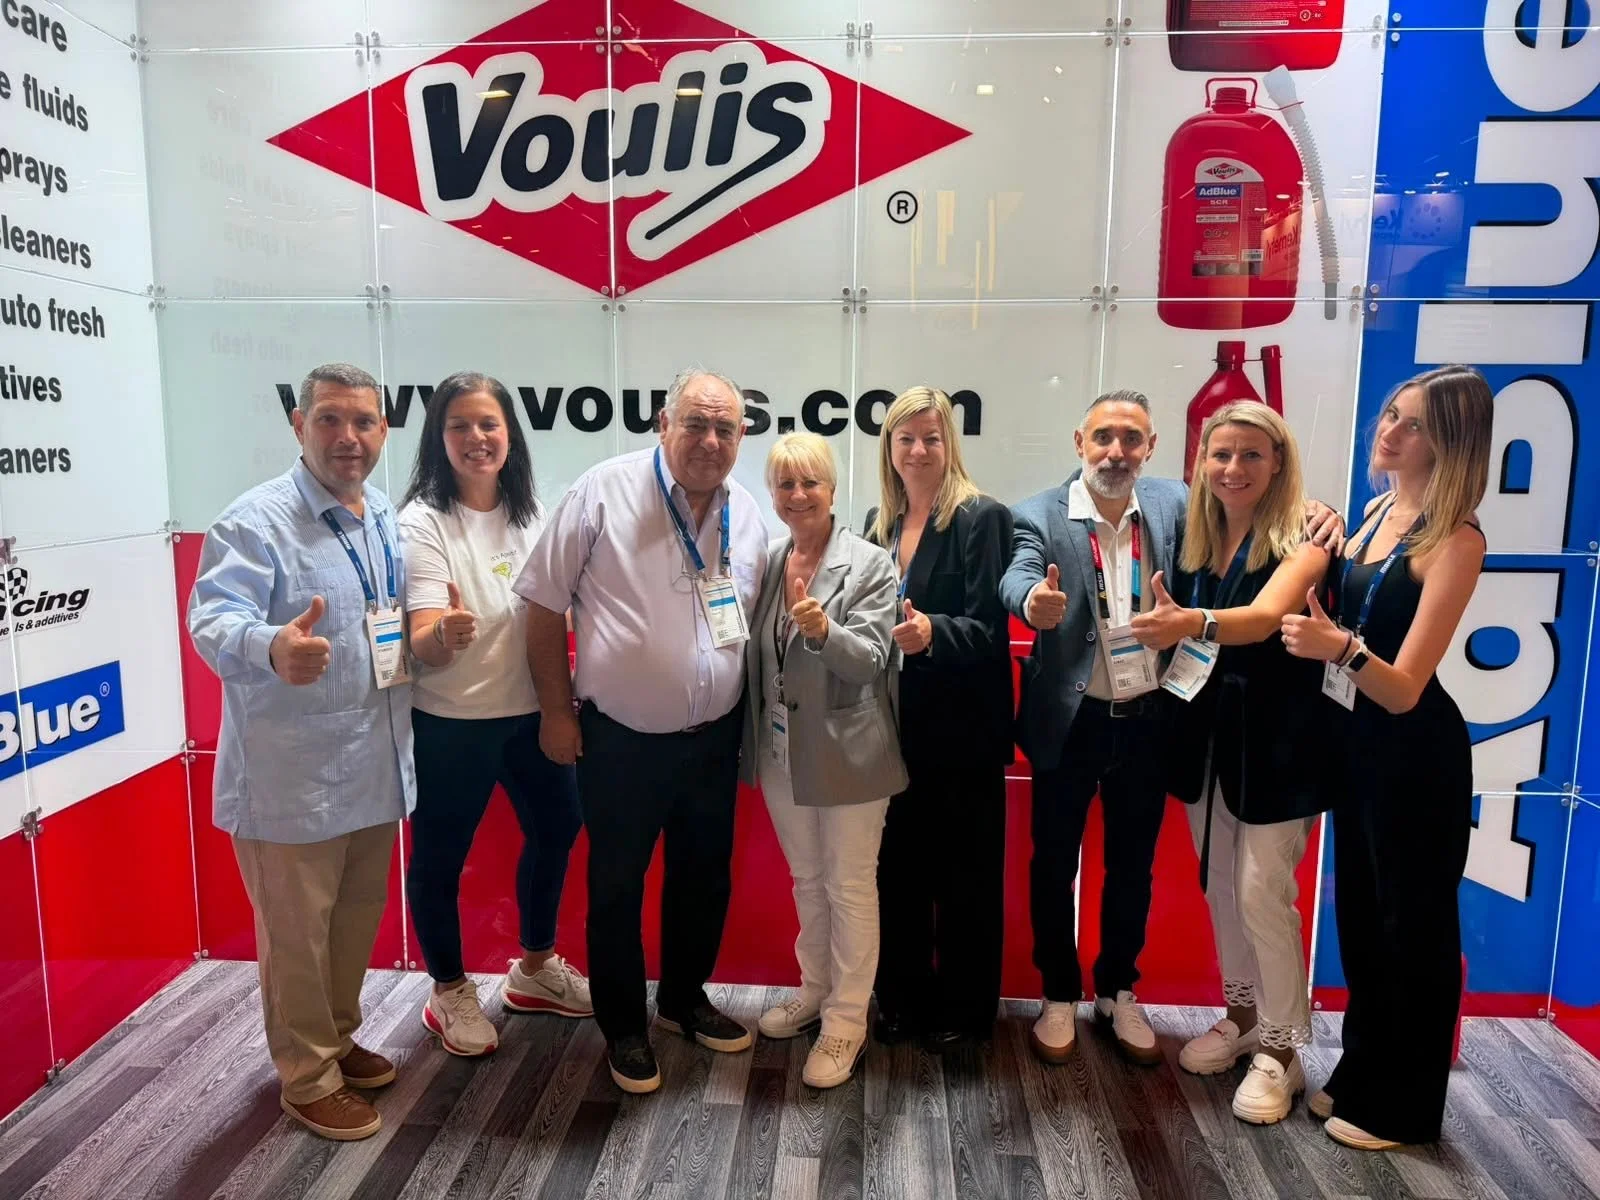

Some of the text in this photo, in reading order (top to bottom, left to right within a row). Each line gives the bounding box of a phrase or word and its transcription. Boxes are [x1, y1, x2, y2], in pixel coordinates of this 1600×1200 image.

[0, 0, 67, 52] care
[23, 73, 89, 132] fluids
[422, 61, 815, 241] Voulis
[1199, 187, 1237, 196] AdBlue
[48, 297, 105, 338] fresh
[0, 365, 62, 402] tives
[0, 447, 71, 475] aners
[35, 611, 80, 628] additives
